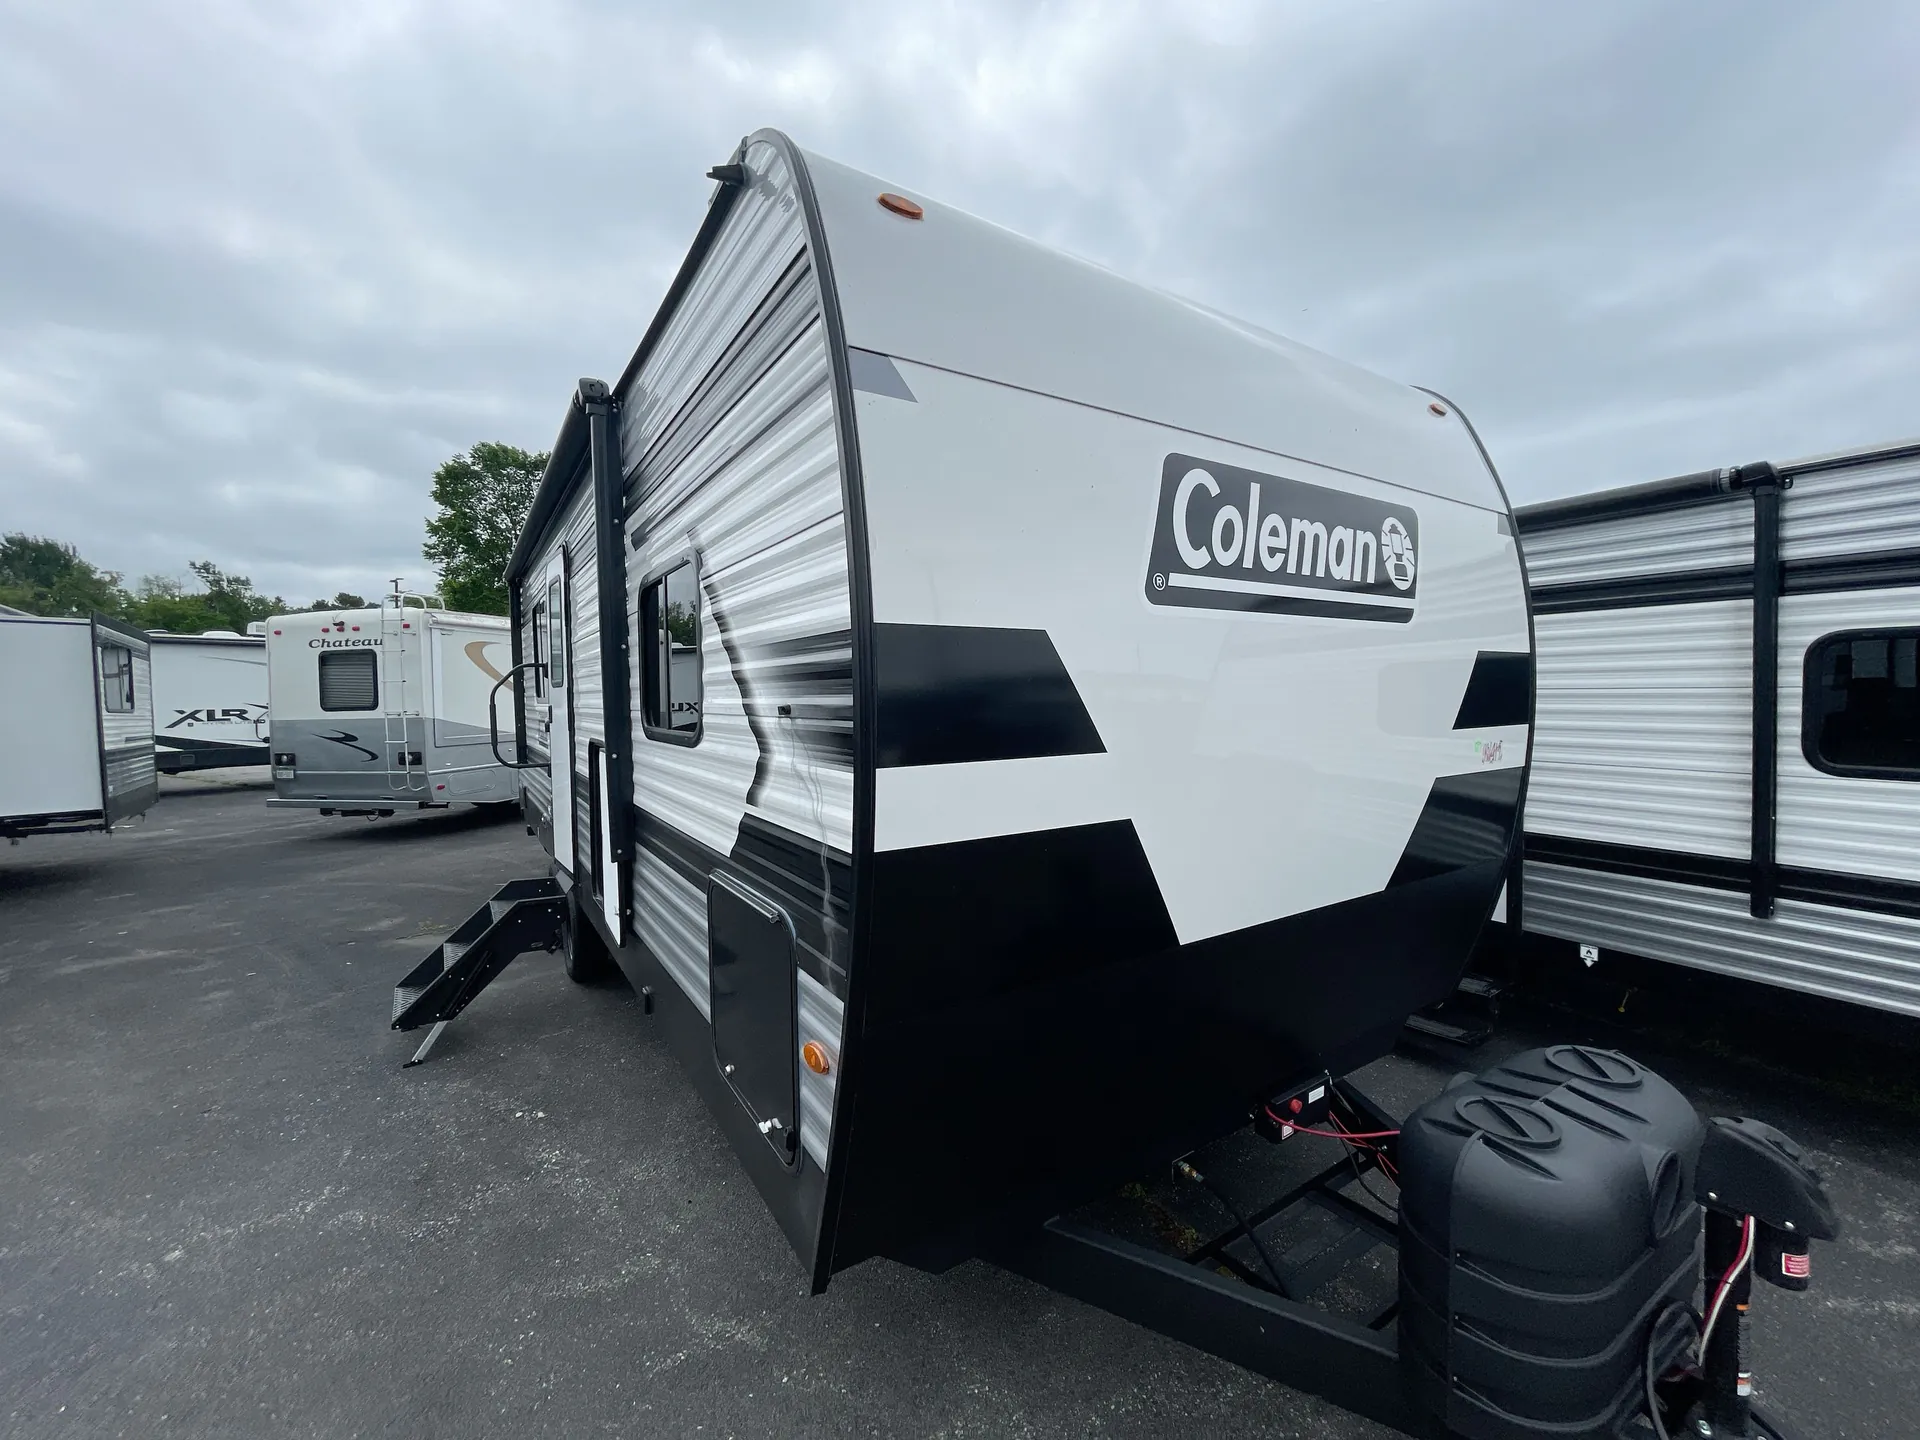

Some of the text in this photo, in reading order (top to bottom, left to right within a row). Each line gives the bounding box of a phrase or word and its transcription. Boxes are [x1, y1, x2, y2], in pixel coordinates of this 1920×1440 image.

[1172, 468, 1378, 584] Coleman
[308, 638, 383, 649] Chateau
[164, 708, 251, 729] XLR
